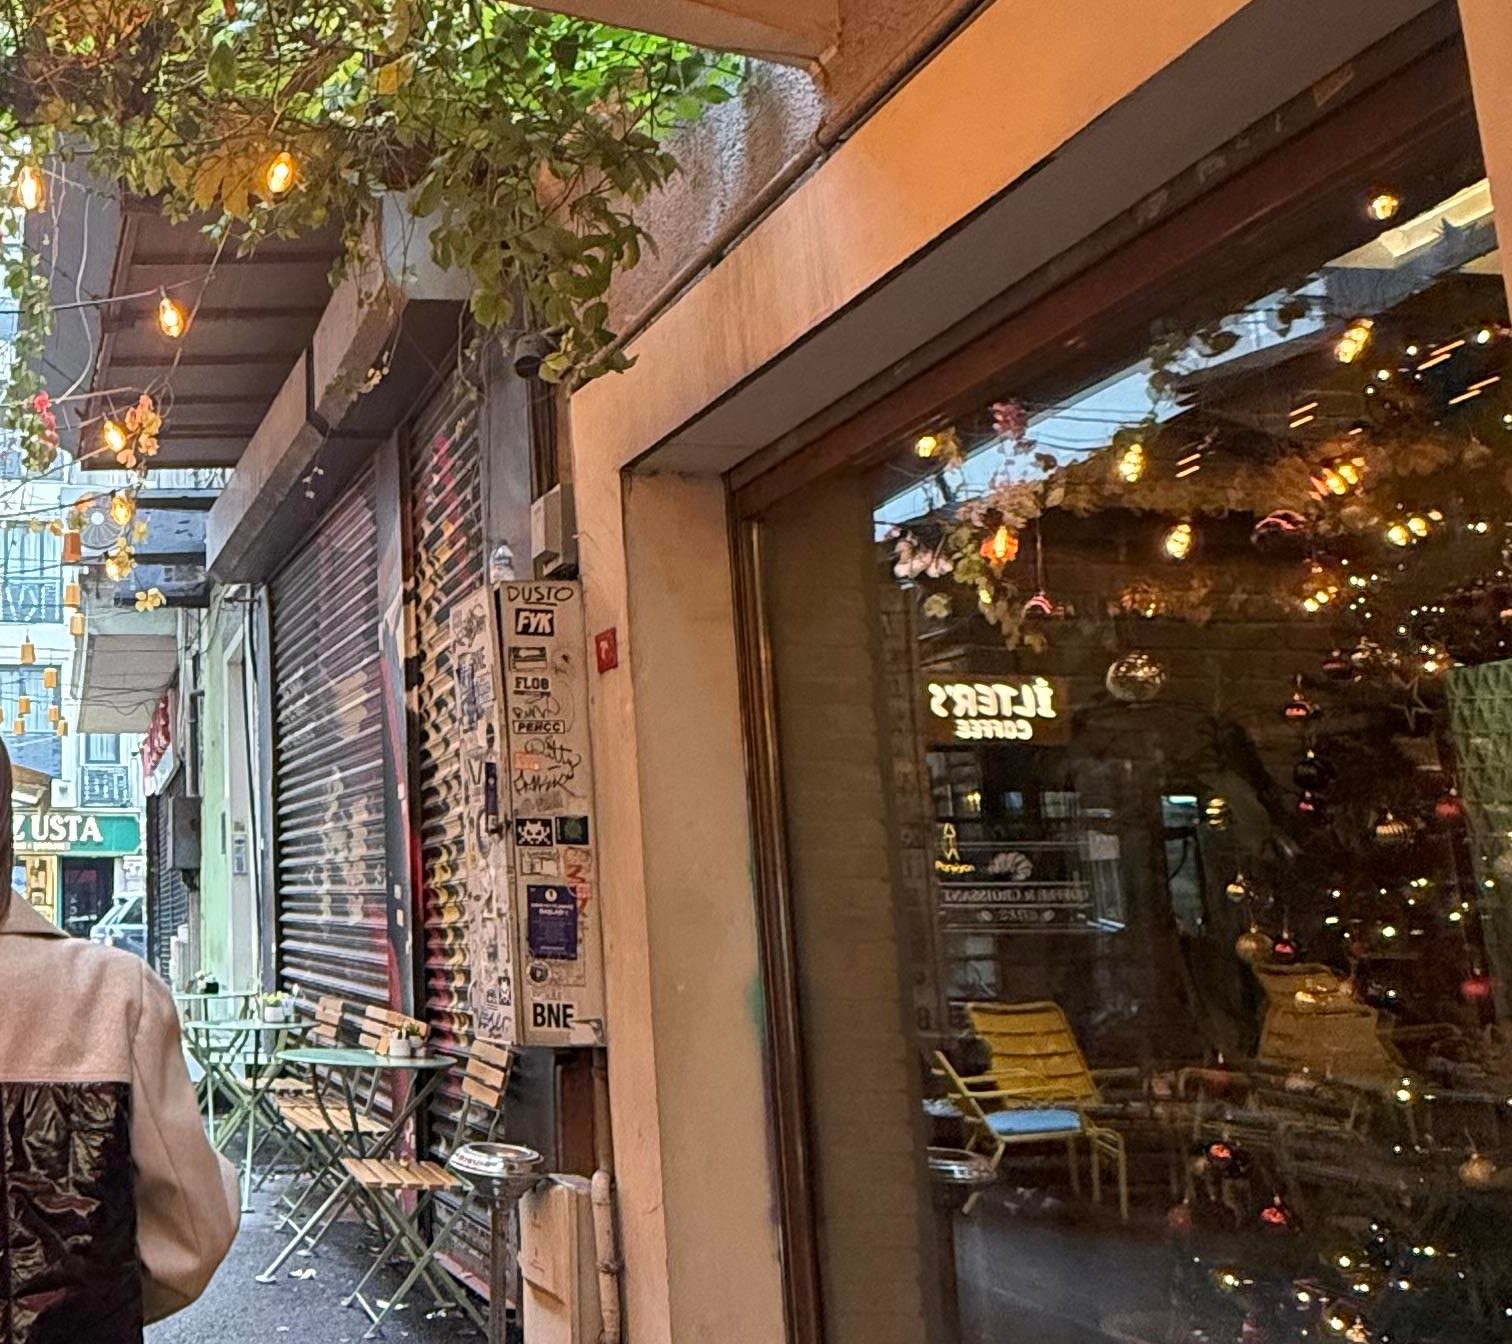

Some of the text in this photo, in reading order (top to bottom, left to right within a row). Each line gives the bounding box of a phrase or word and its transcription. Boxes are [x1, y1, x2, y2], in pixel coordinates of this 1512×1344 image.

[516, 610, 553, 634] FYK
[31, 814, 104, 842] USTA
[533, 1003, 575, 1029] BNE
